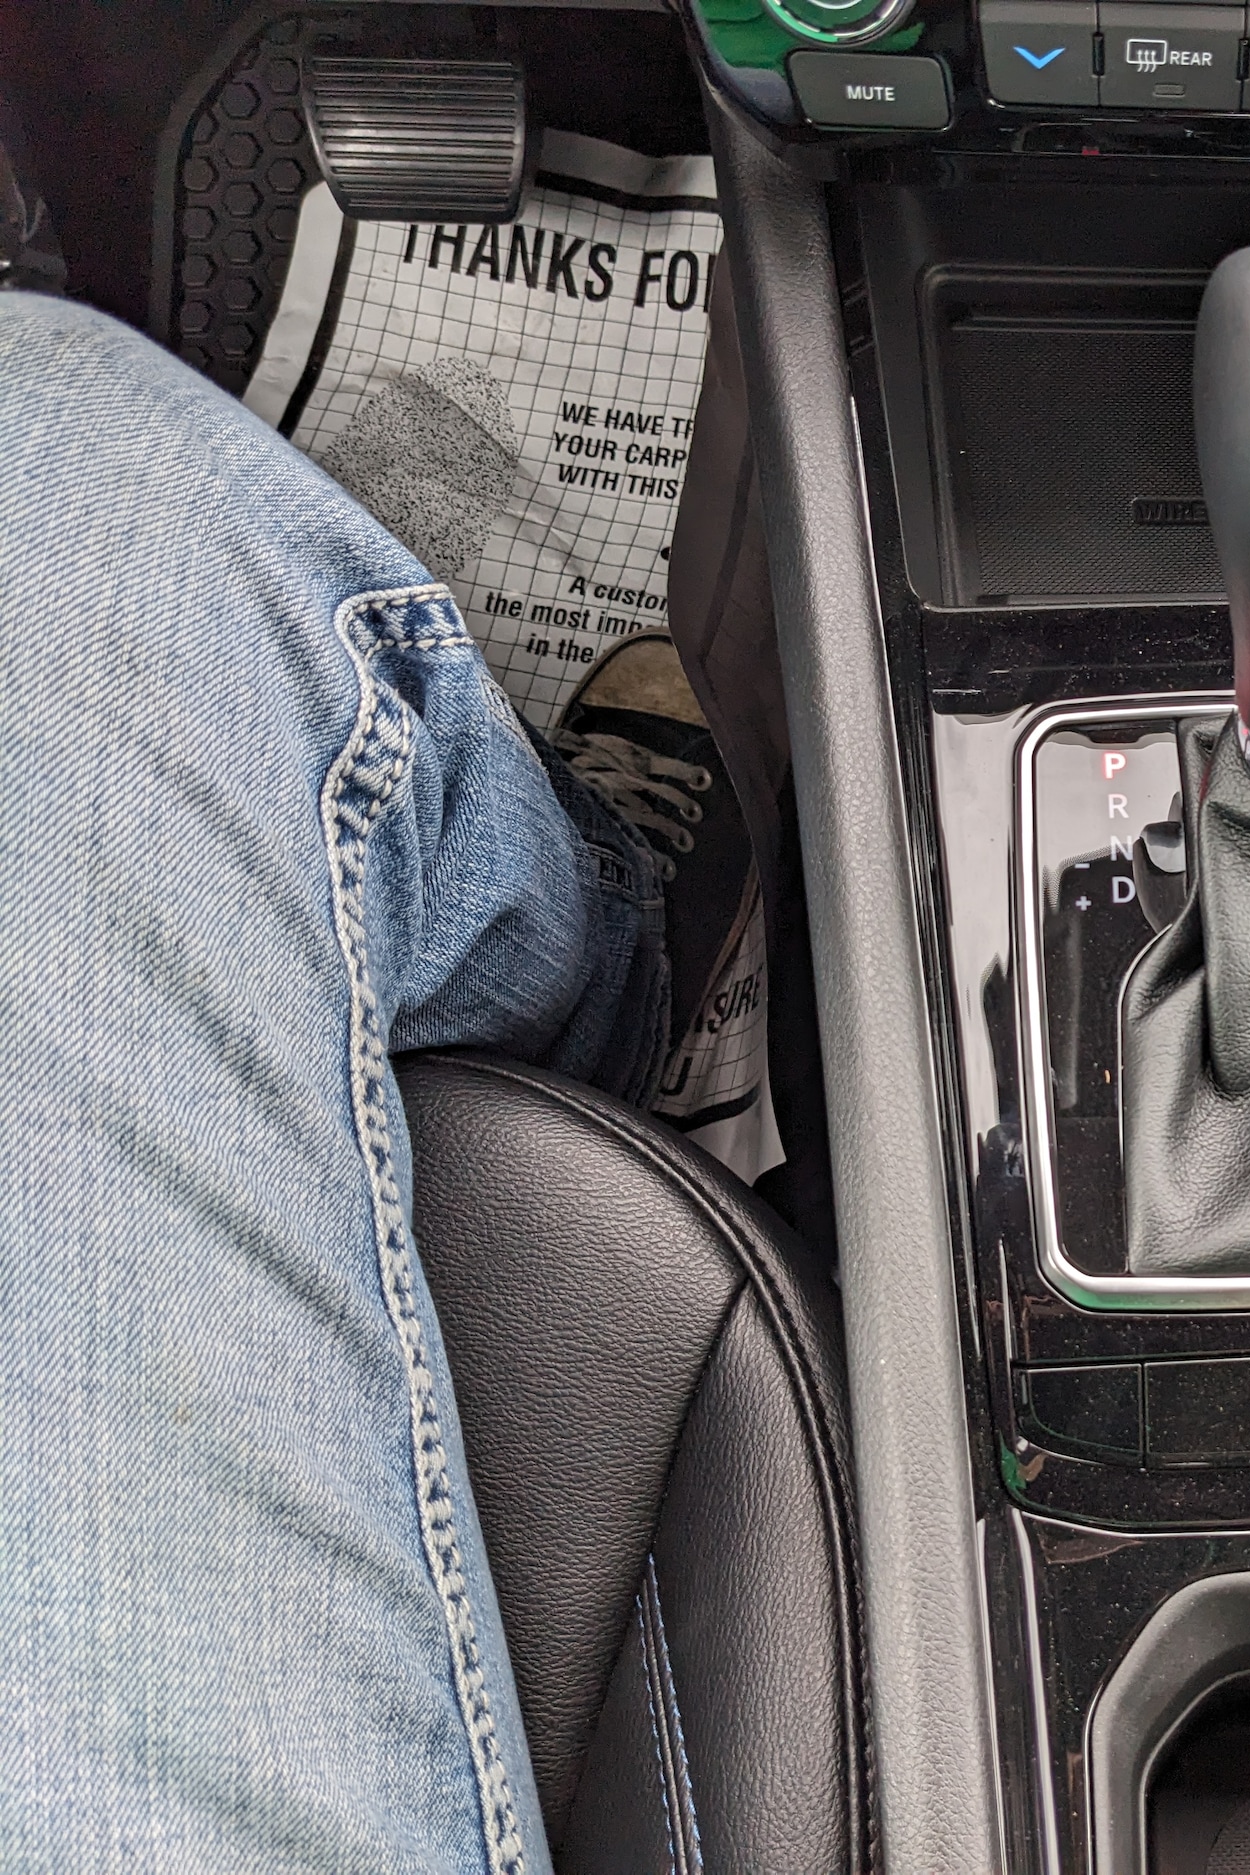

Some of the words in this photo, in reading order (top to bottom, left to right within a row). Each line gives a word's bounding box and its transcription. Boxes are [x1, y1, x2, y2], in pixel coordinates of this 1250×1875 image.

[1169, 49, 1213, 67] REAR
[846, 84, 896, 102] MUTE
[562, 401, 600, 425] WE
[604, 408, 665, 437] HAVE
[552, 431, 616, 462] YOUR
[558, 463, 619, 492] WITH
[627, 474, 679, 500] THIS
[568, 576, 586, 596] A
[485, 592, 521, 619] the
[530, 603, 591, 631] most
[526, 634, 549, 656] in
[557, 637, 594, 664] the
[1103, 752, 1127, 780] P
[1108, 793, 1130, 819] R
[1110, 835, 1134, 862] N
[1111, 875, 1136, 904] D
